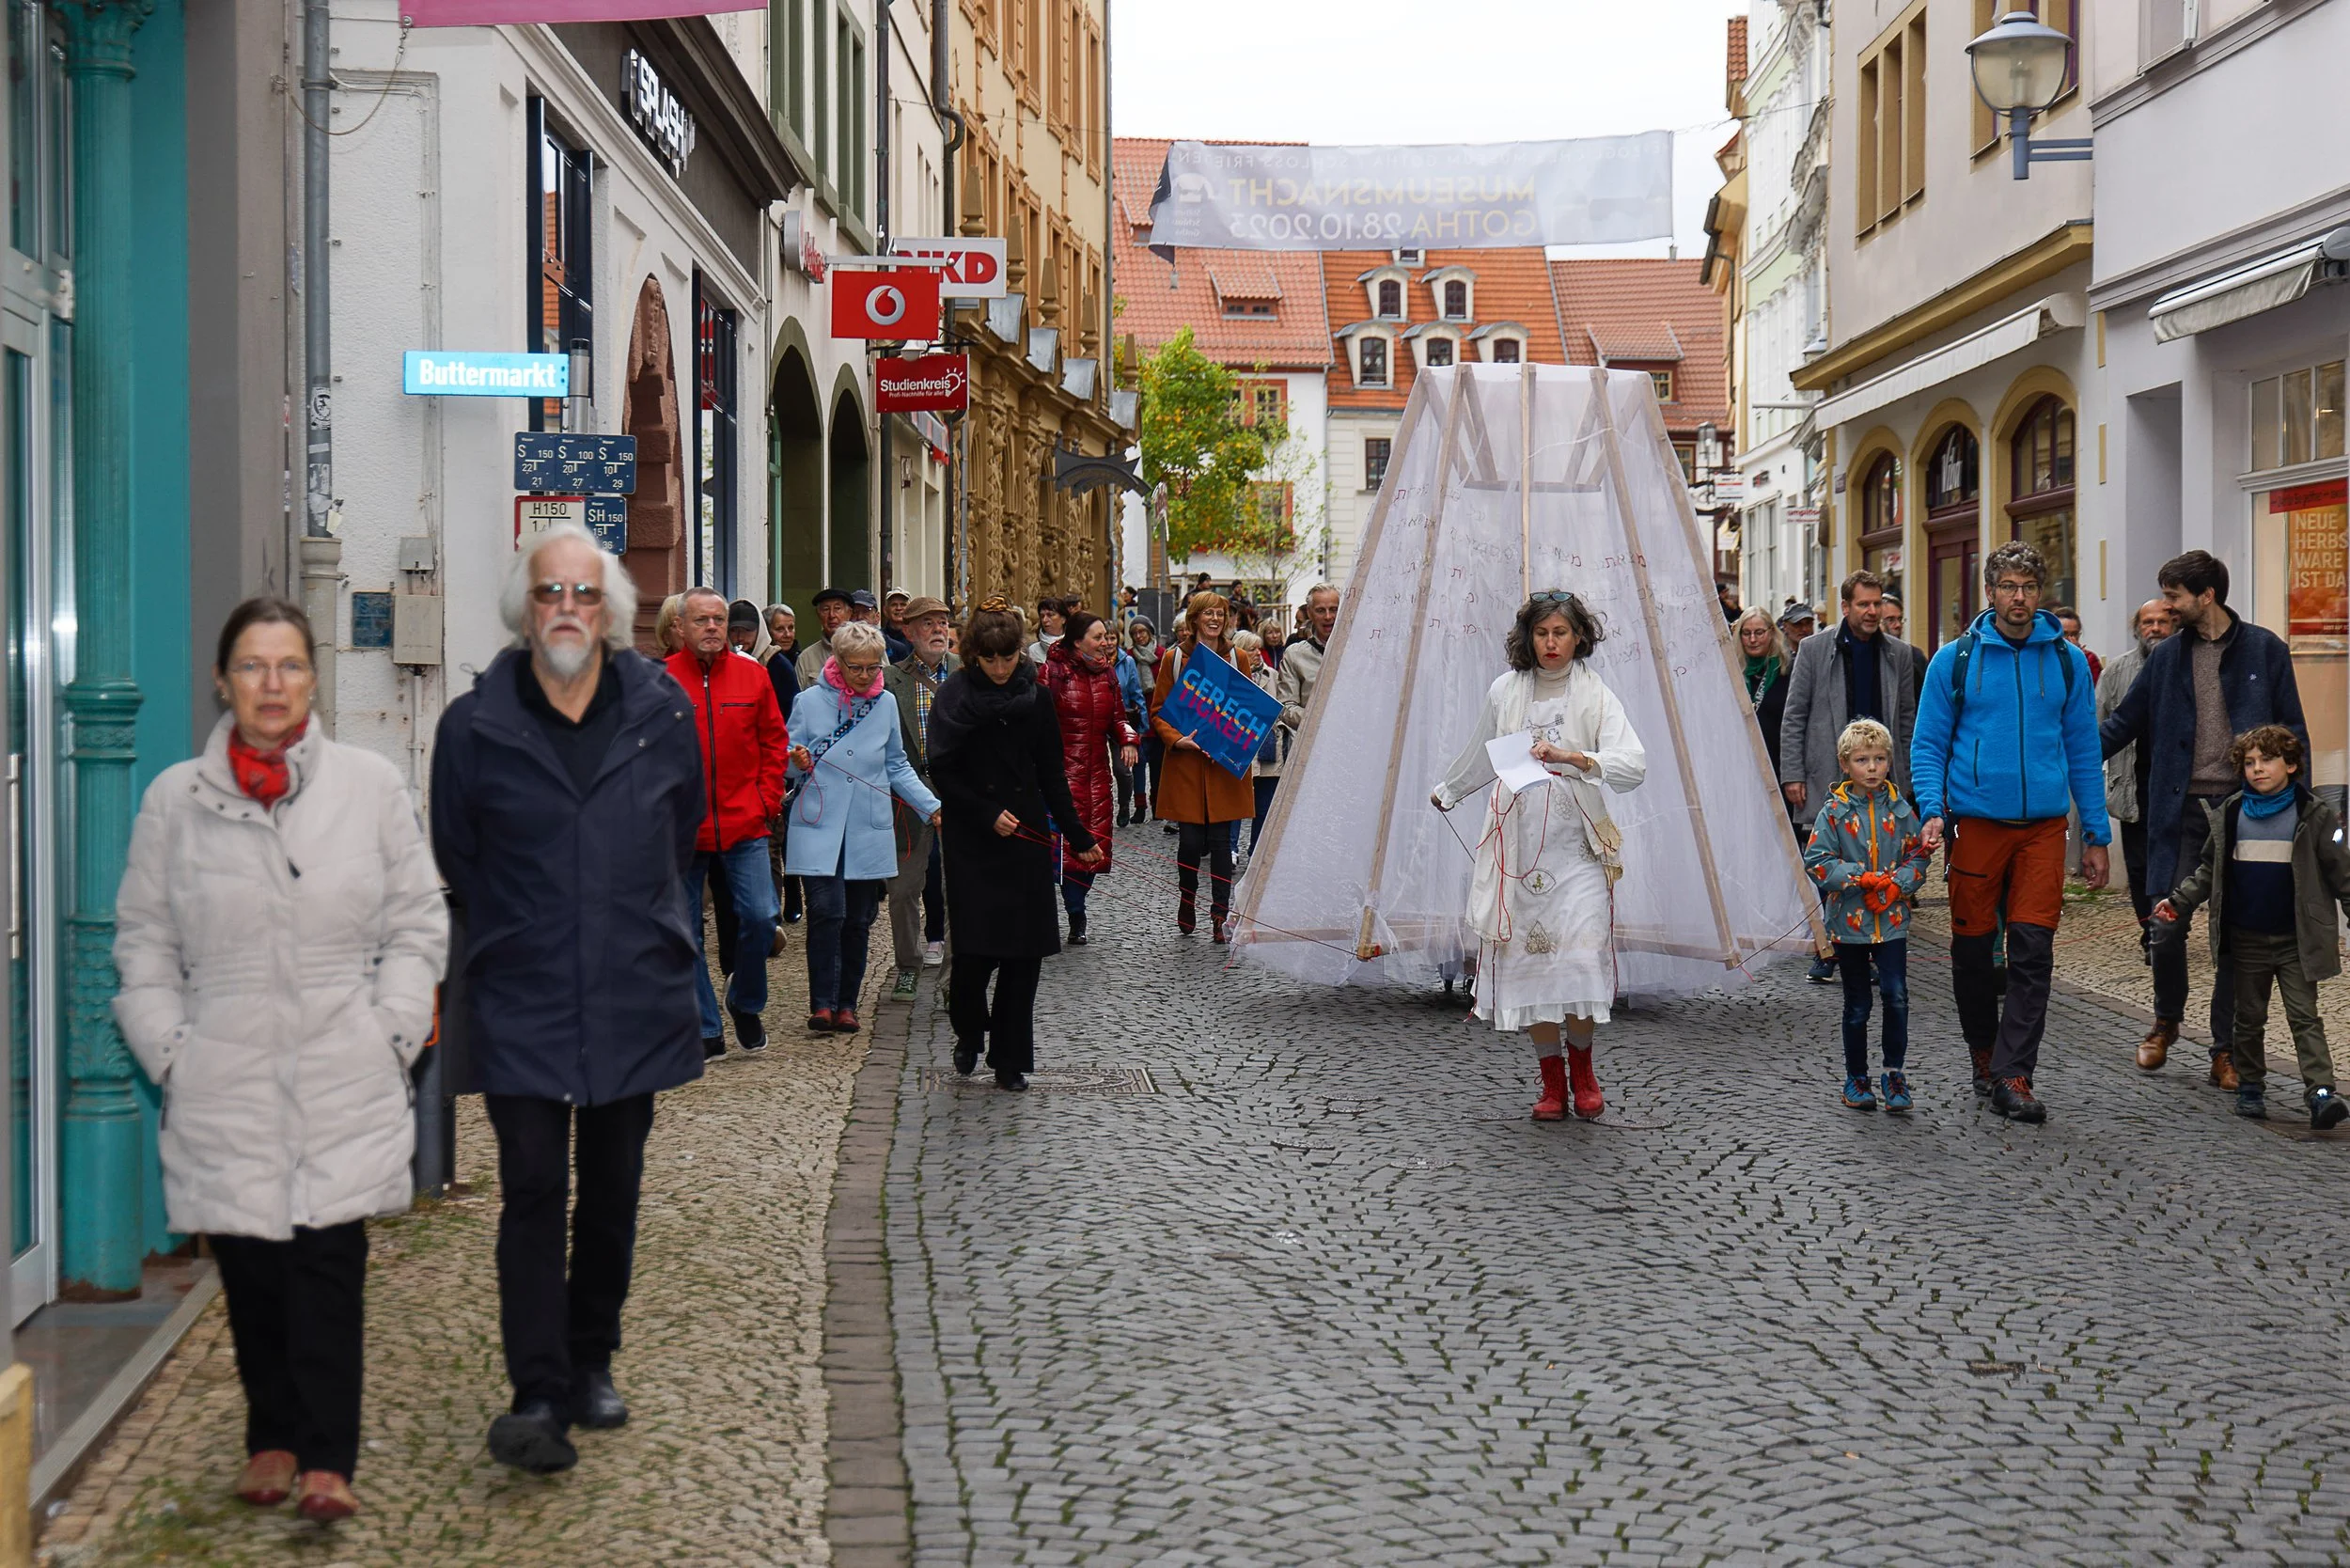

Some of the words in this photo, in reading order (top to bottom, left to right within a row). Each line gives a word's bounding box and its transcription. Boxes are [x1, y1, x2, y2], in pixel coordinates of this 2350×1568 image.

[419, 358, 556, 387] Buttermarkt
[880, 376, 951, 392] Studienkreis
[517, 444, 526, 458] S
[538, 449, 554, 459] 150
[557, 446, 567, 459] S
[578, 450, 594, 460] 100
[598, 447, 607, 461] S
[619, 452, 634, 462] 150
[531, 477, 542, 485] 21
[572, 478, 584, 487] 27
[612, 479, 623, 488] 29
[533, 502, 567, 515] H150
[588, 509, 605, 522] SH
[607, 513, 623, 523] 150
[2295, 512, 2338, 530] NEUE
[2295, 552, 2343, 569] WARE
[2295, 571, 2320, 588] IST
[2326, 571, 2347, 588] DA
[1183, 668, 1267, 742] GERECH
